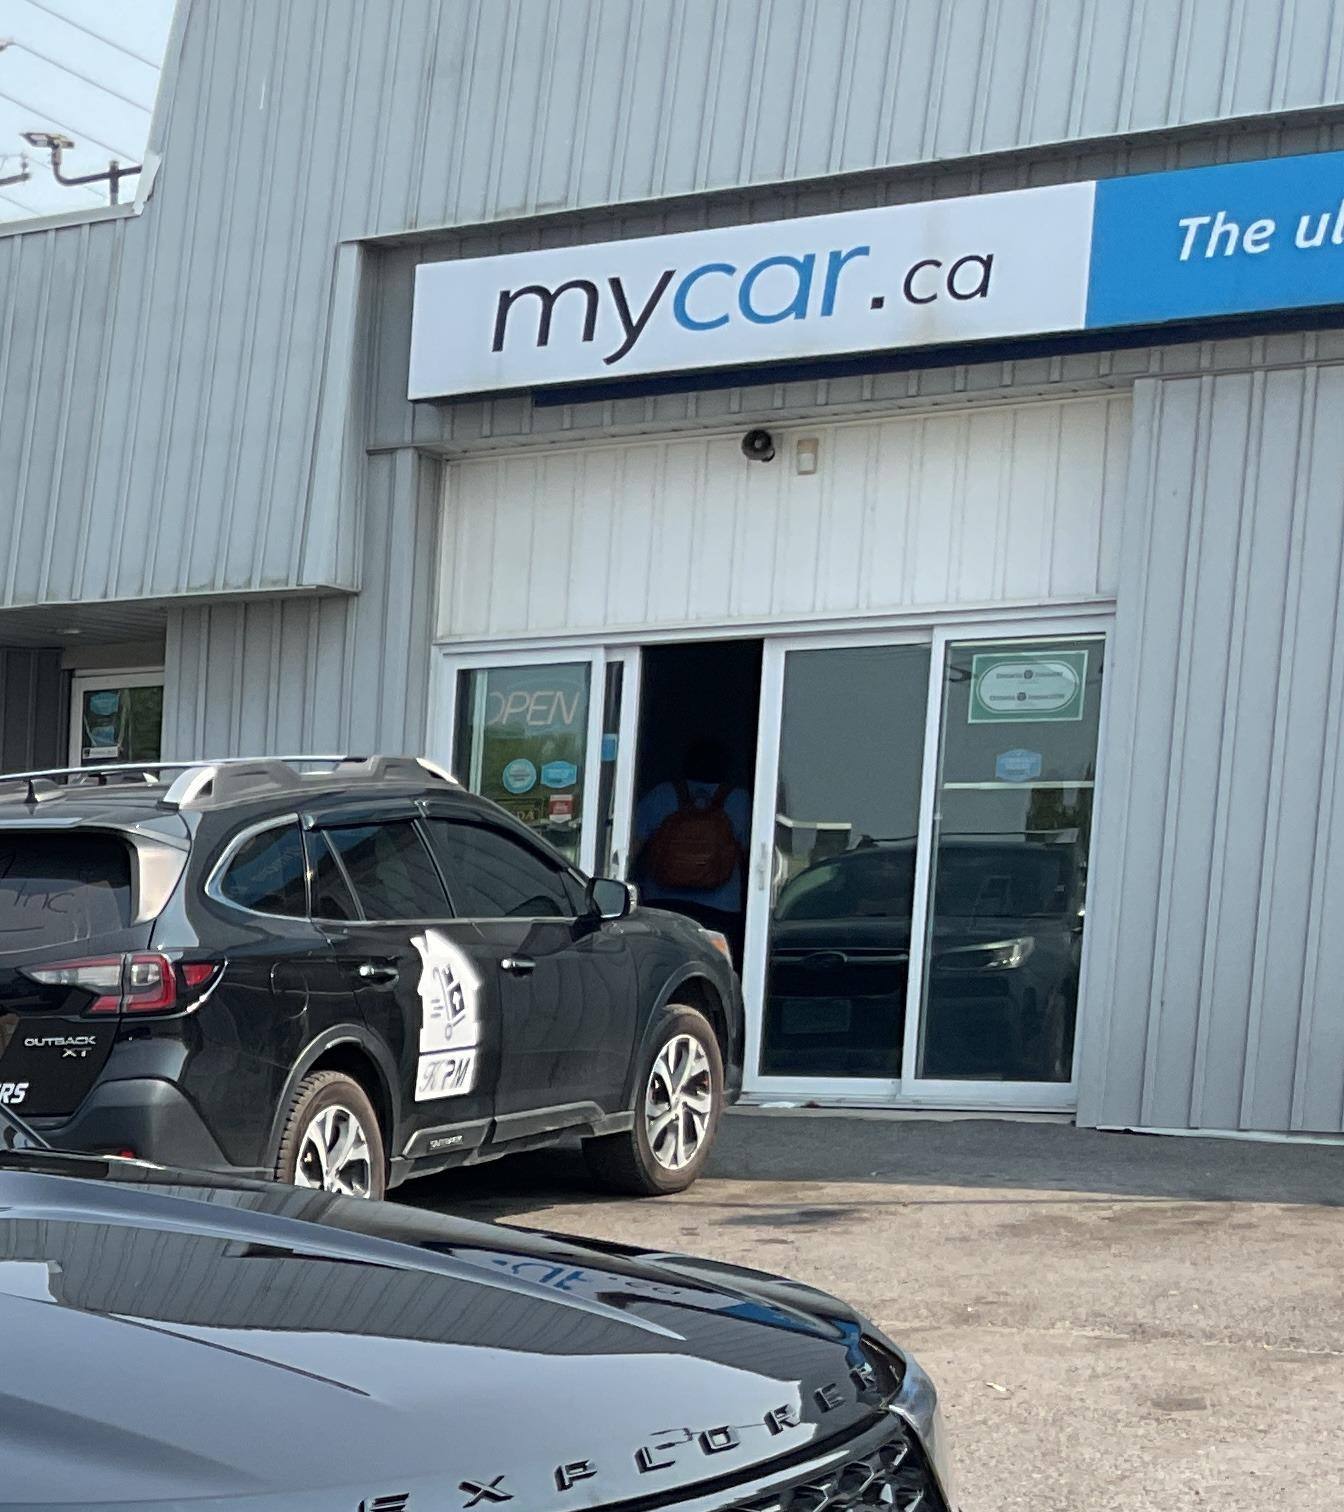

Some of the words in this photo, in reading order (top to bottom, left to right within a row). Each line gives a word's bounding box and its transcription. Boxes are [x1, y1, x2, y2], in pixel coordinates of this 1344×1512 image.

[1179, 210, 1276, 261] The
[492, 246, 994, 366] mycar.ca
[487, 690, 581, 726] OPEN
[24, 1036, 96, 1047] OUTBACK
[62, 1047, 92, 1058] XT
